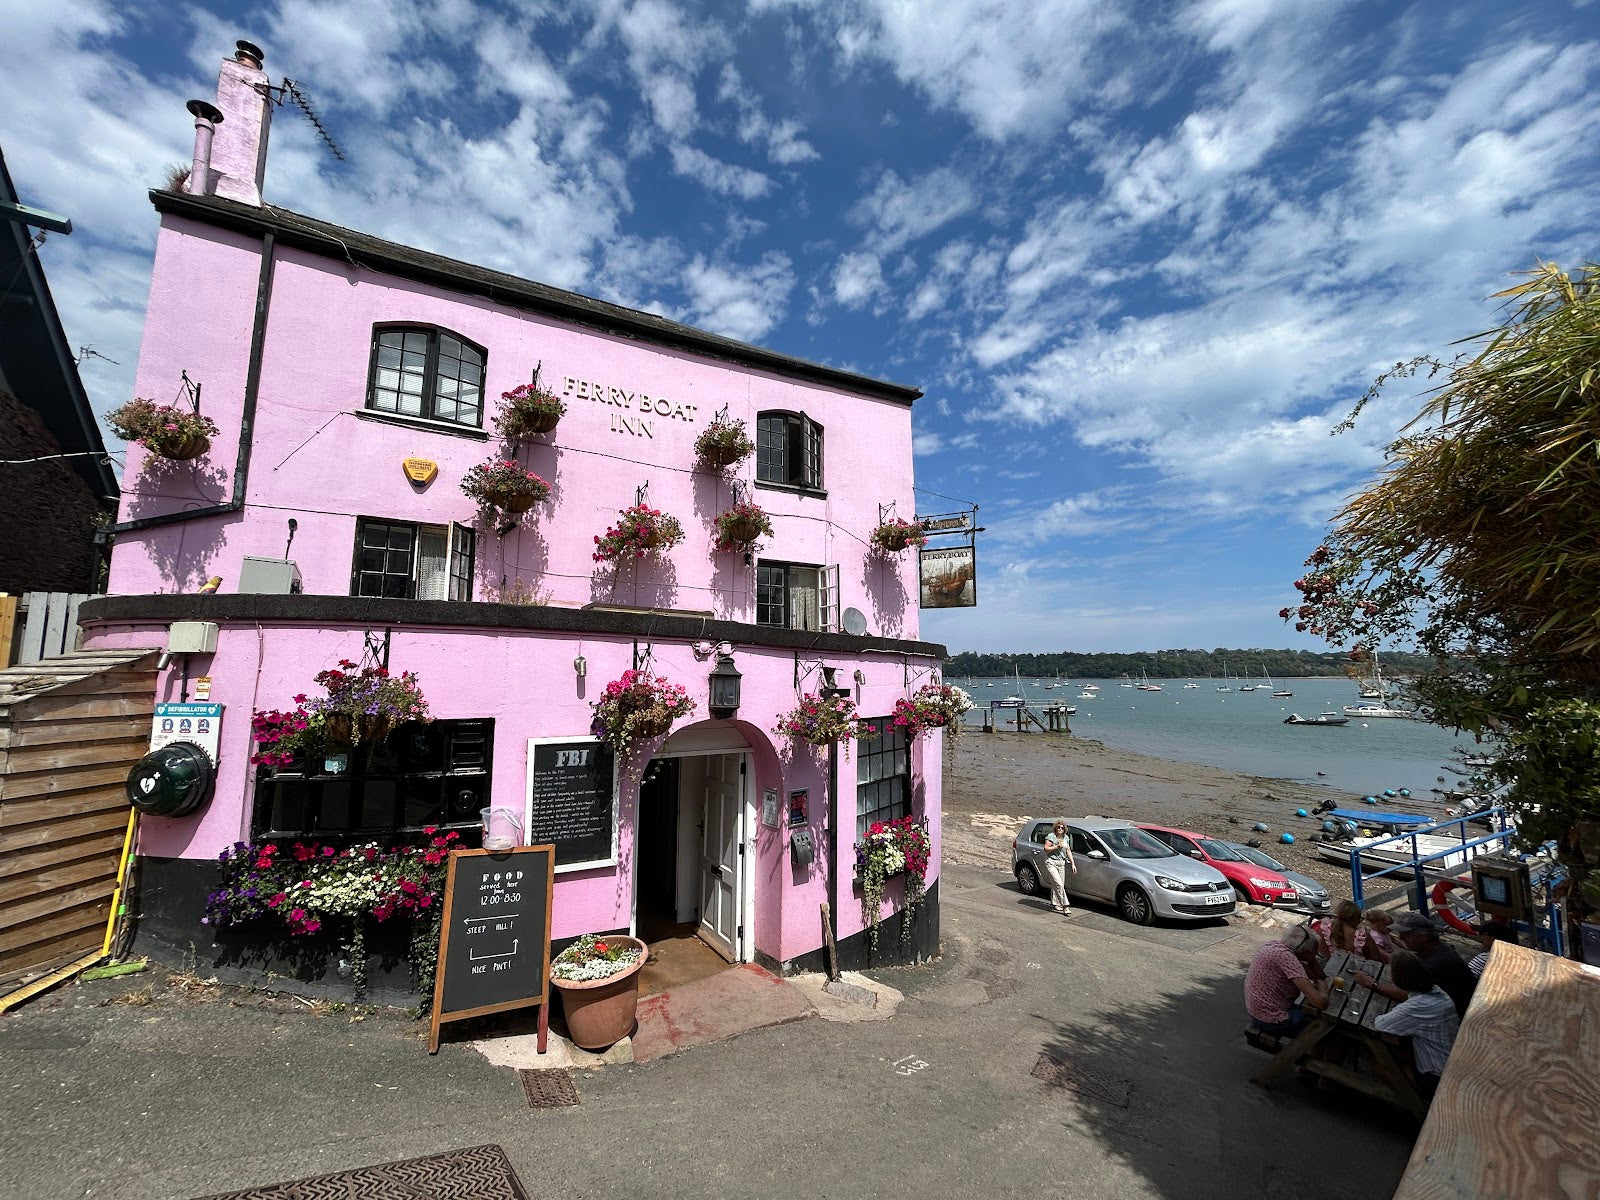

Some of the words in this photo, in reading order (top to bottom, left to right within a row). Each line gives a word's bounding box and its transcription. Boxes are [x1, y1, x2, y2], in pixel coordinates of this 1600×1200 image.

[563, 376, 634, 409] FERRY
[640, 393, 698, 422] BOAT
[610, 413, 654, 439] INN
[555, 749, 590, 767] FBI
[483, 871, 523, 882] FOOD
[466, 926, 486, 935] STEEP
[471, 965, 487, 975] NICE
